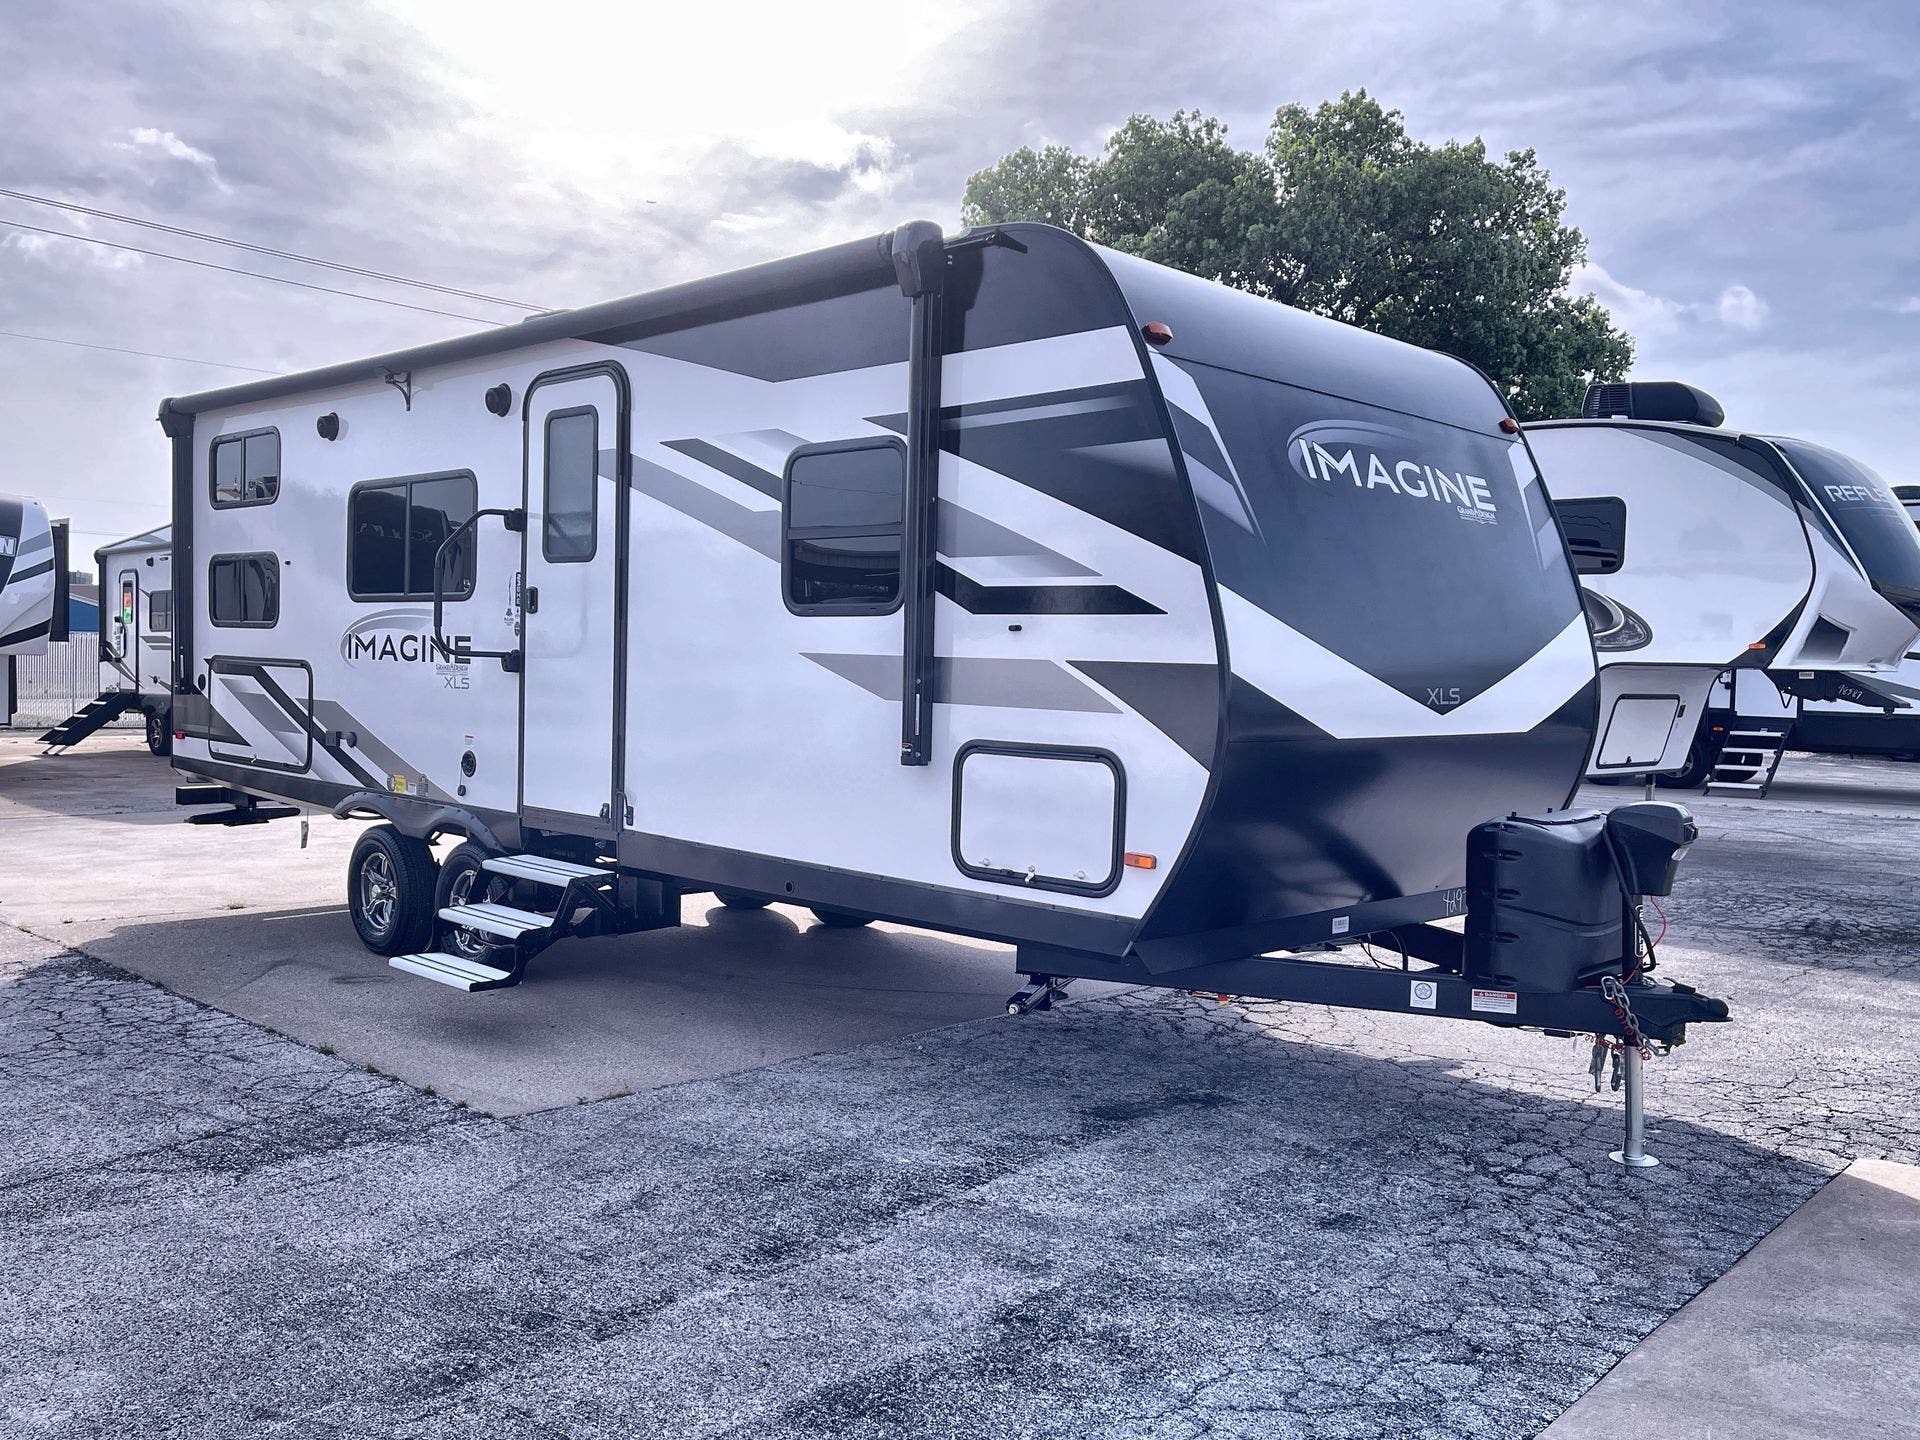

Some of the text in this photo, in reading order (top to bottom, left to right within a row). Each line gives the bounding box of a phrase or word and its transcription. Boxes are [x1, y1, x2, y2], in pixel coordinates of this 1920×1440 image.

[1298, 438, 1497, 512] IMAGINE
[347, 634, 471, 664] IMAGINE
[444, 676, 470, 690] XLS
[1427, 687, 1461, 705] XLS
